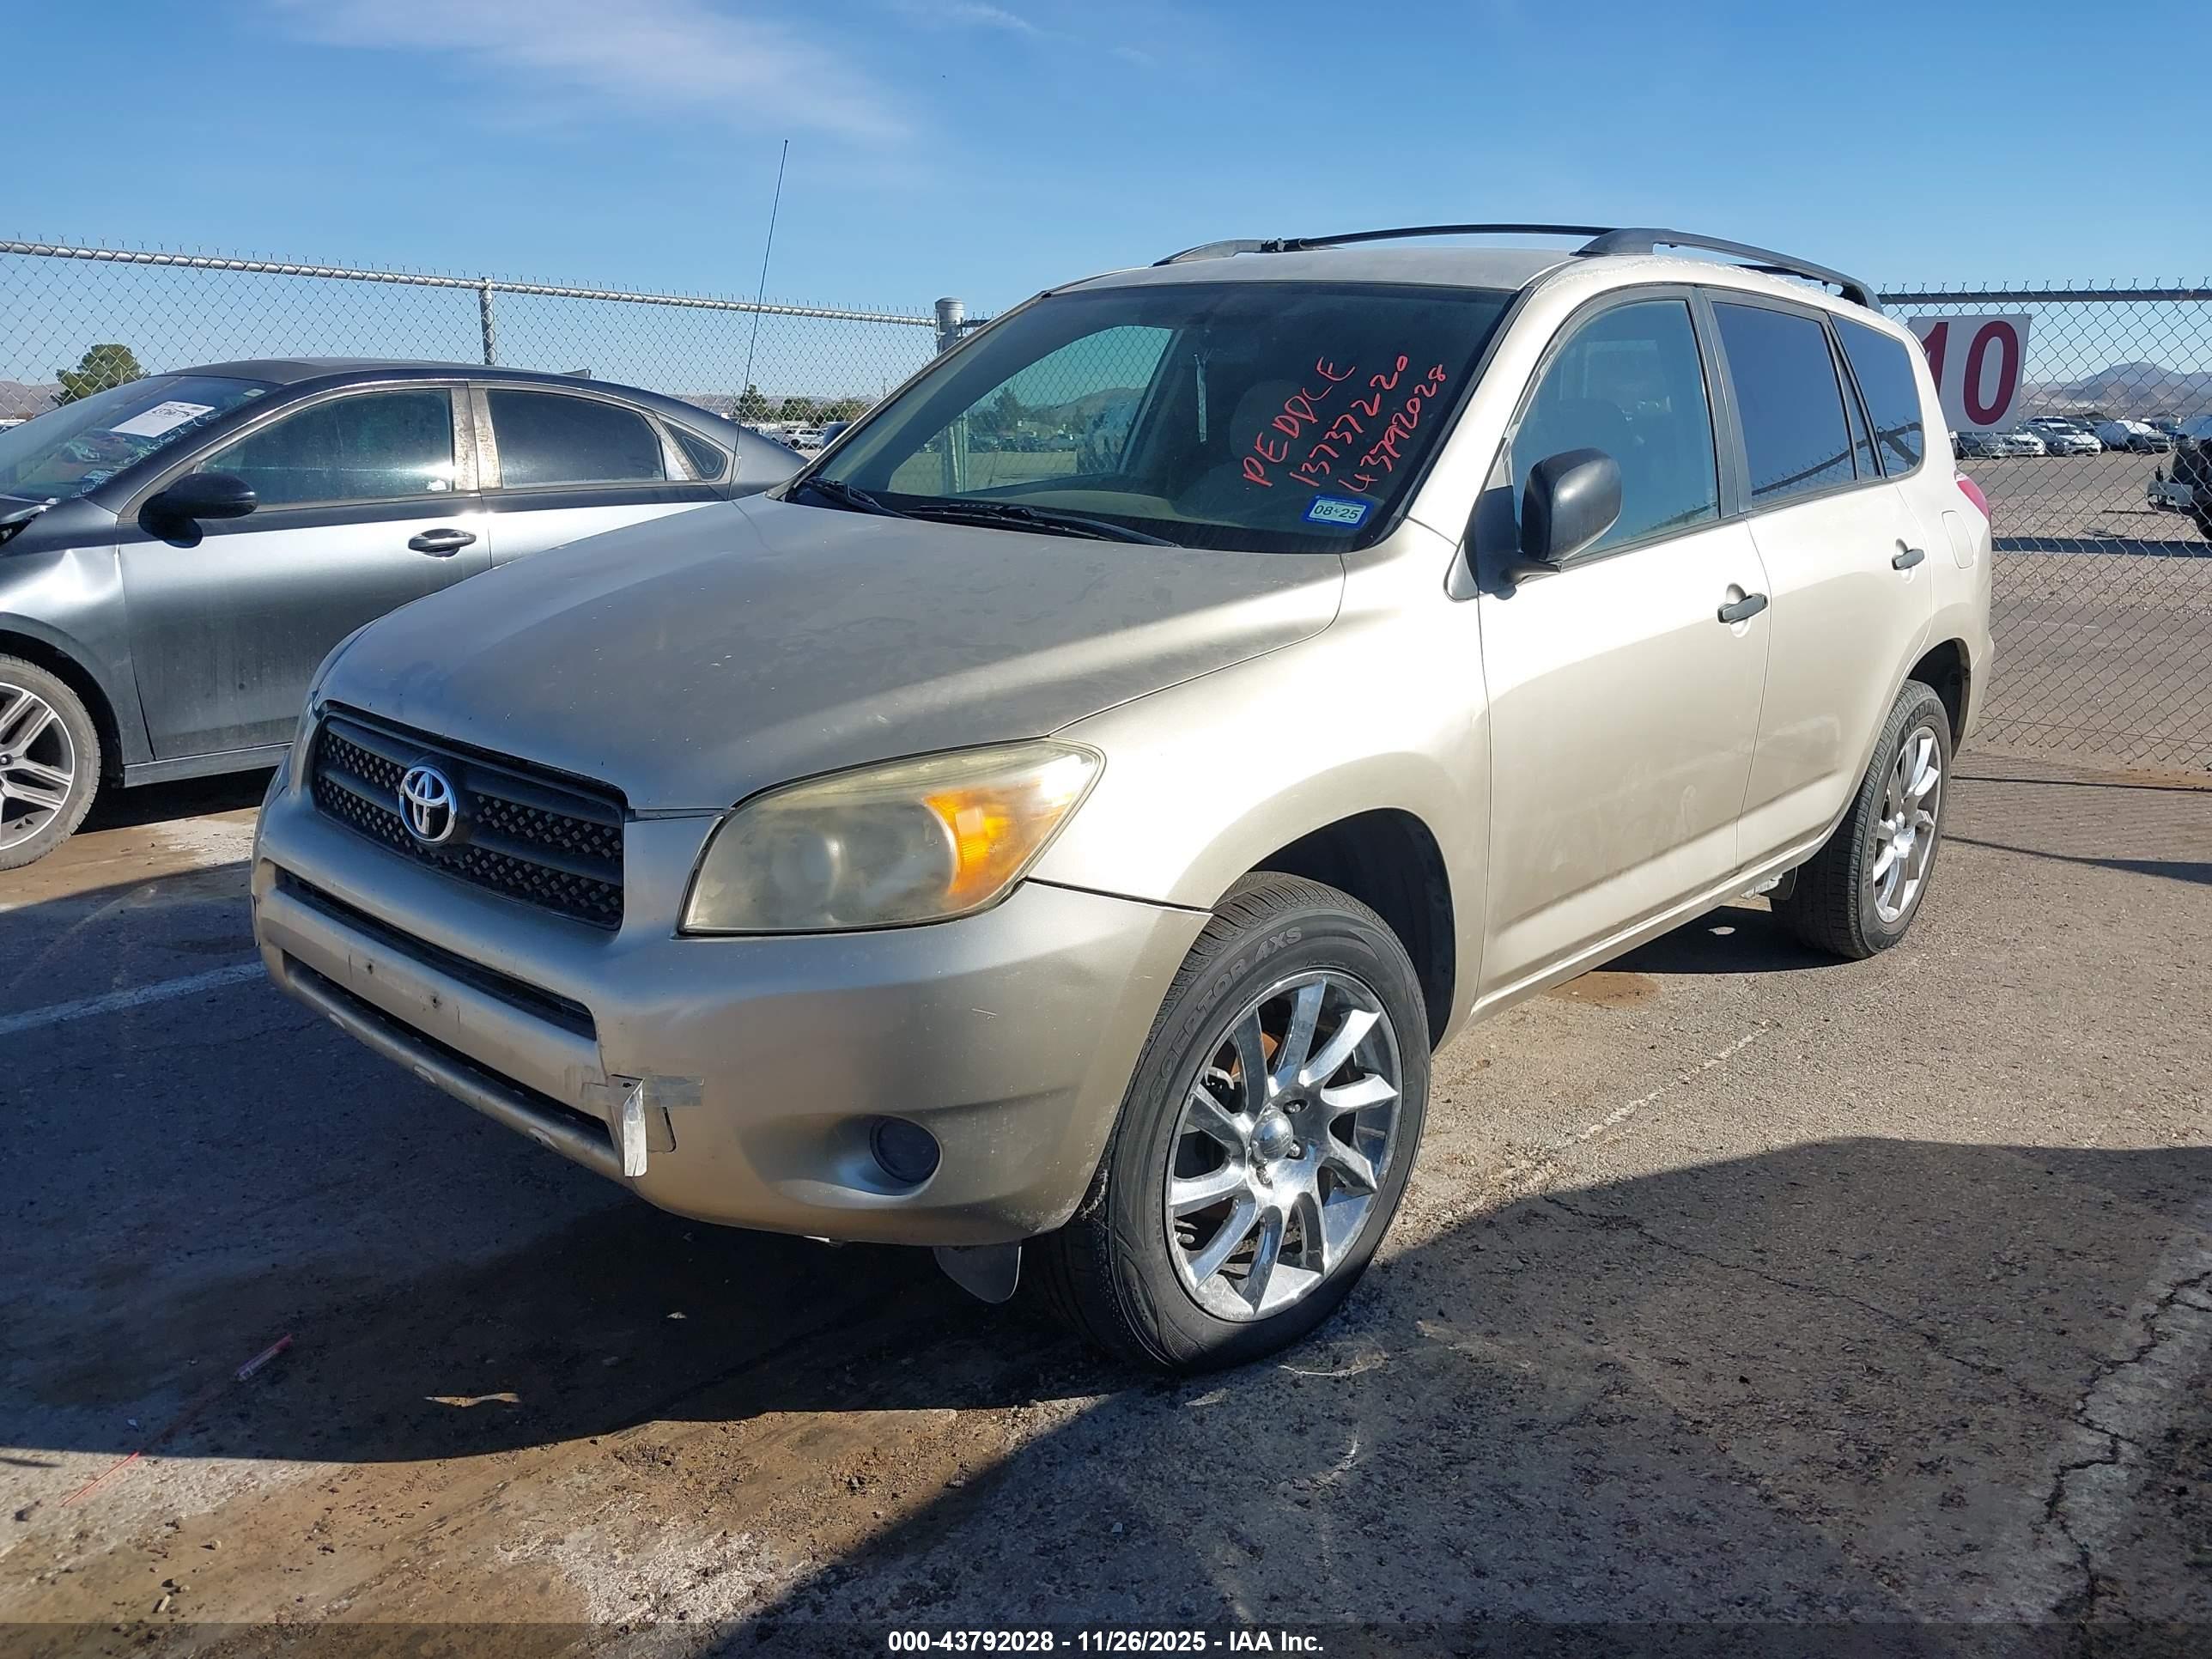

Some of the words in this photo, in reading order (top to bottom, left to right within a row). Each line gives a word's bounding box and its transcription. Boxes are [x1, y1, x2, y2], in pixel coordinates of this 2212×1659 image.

[1289, 355, 1409, 488] 13737220
[1922, 319, 2020, 426] 10
[1338, 363, 1449, 492] 43792028
[1314, 504, 1334, 516] 08
[1339, 508, 1360, 520] 25
[1254, 926, 1303, 963] 4XS
